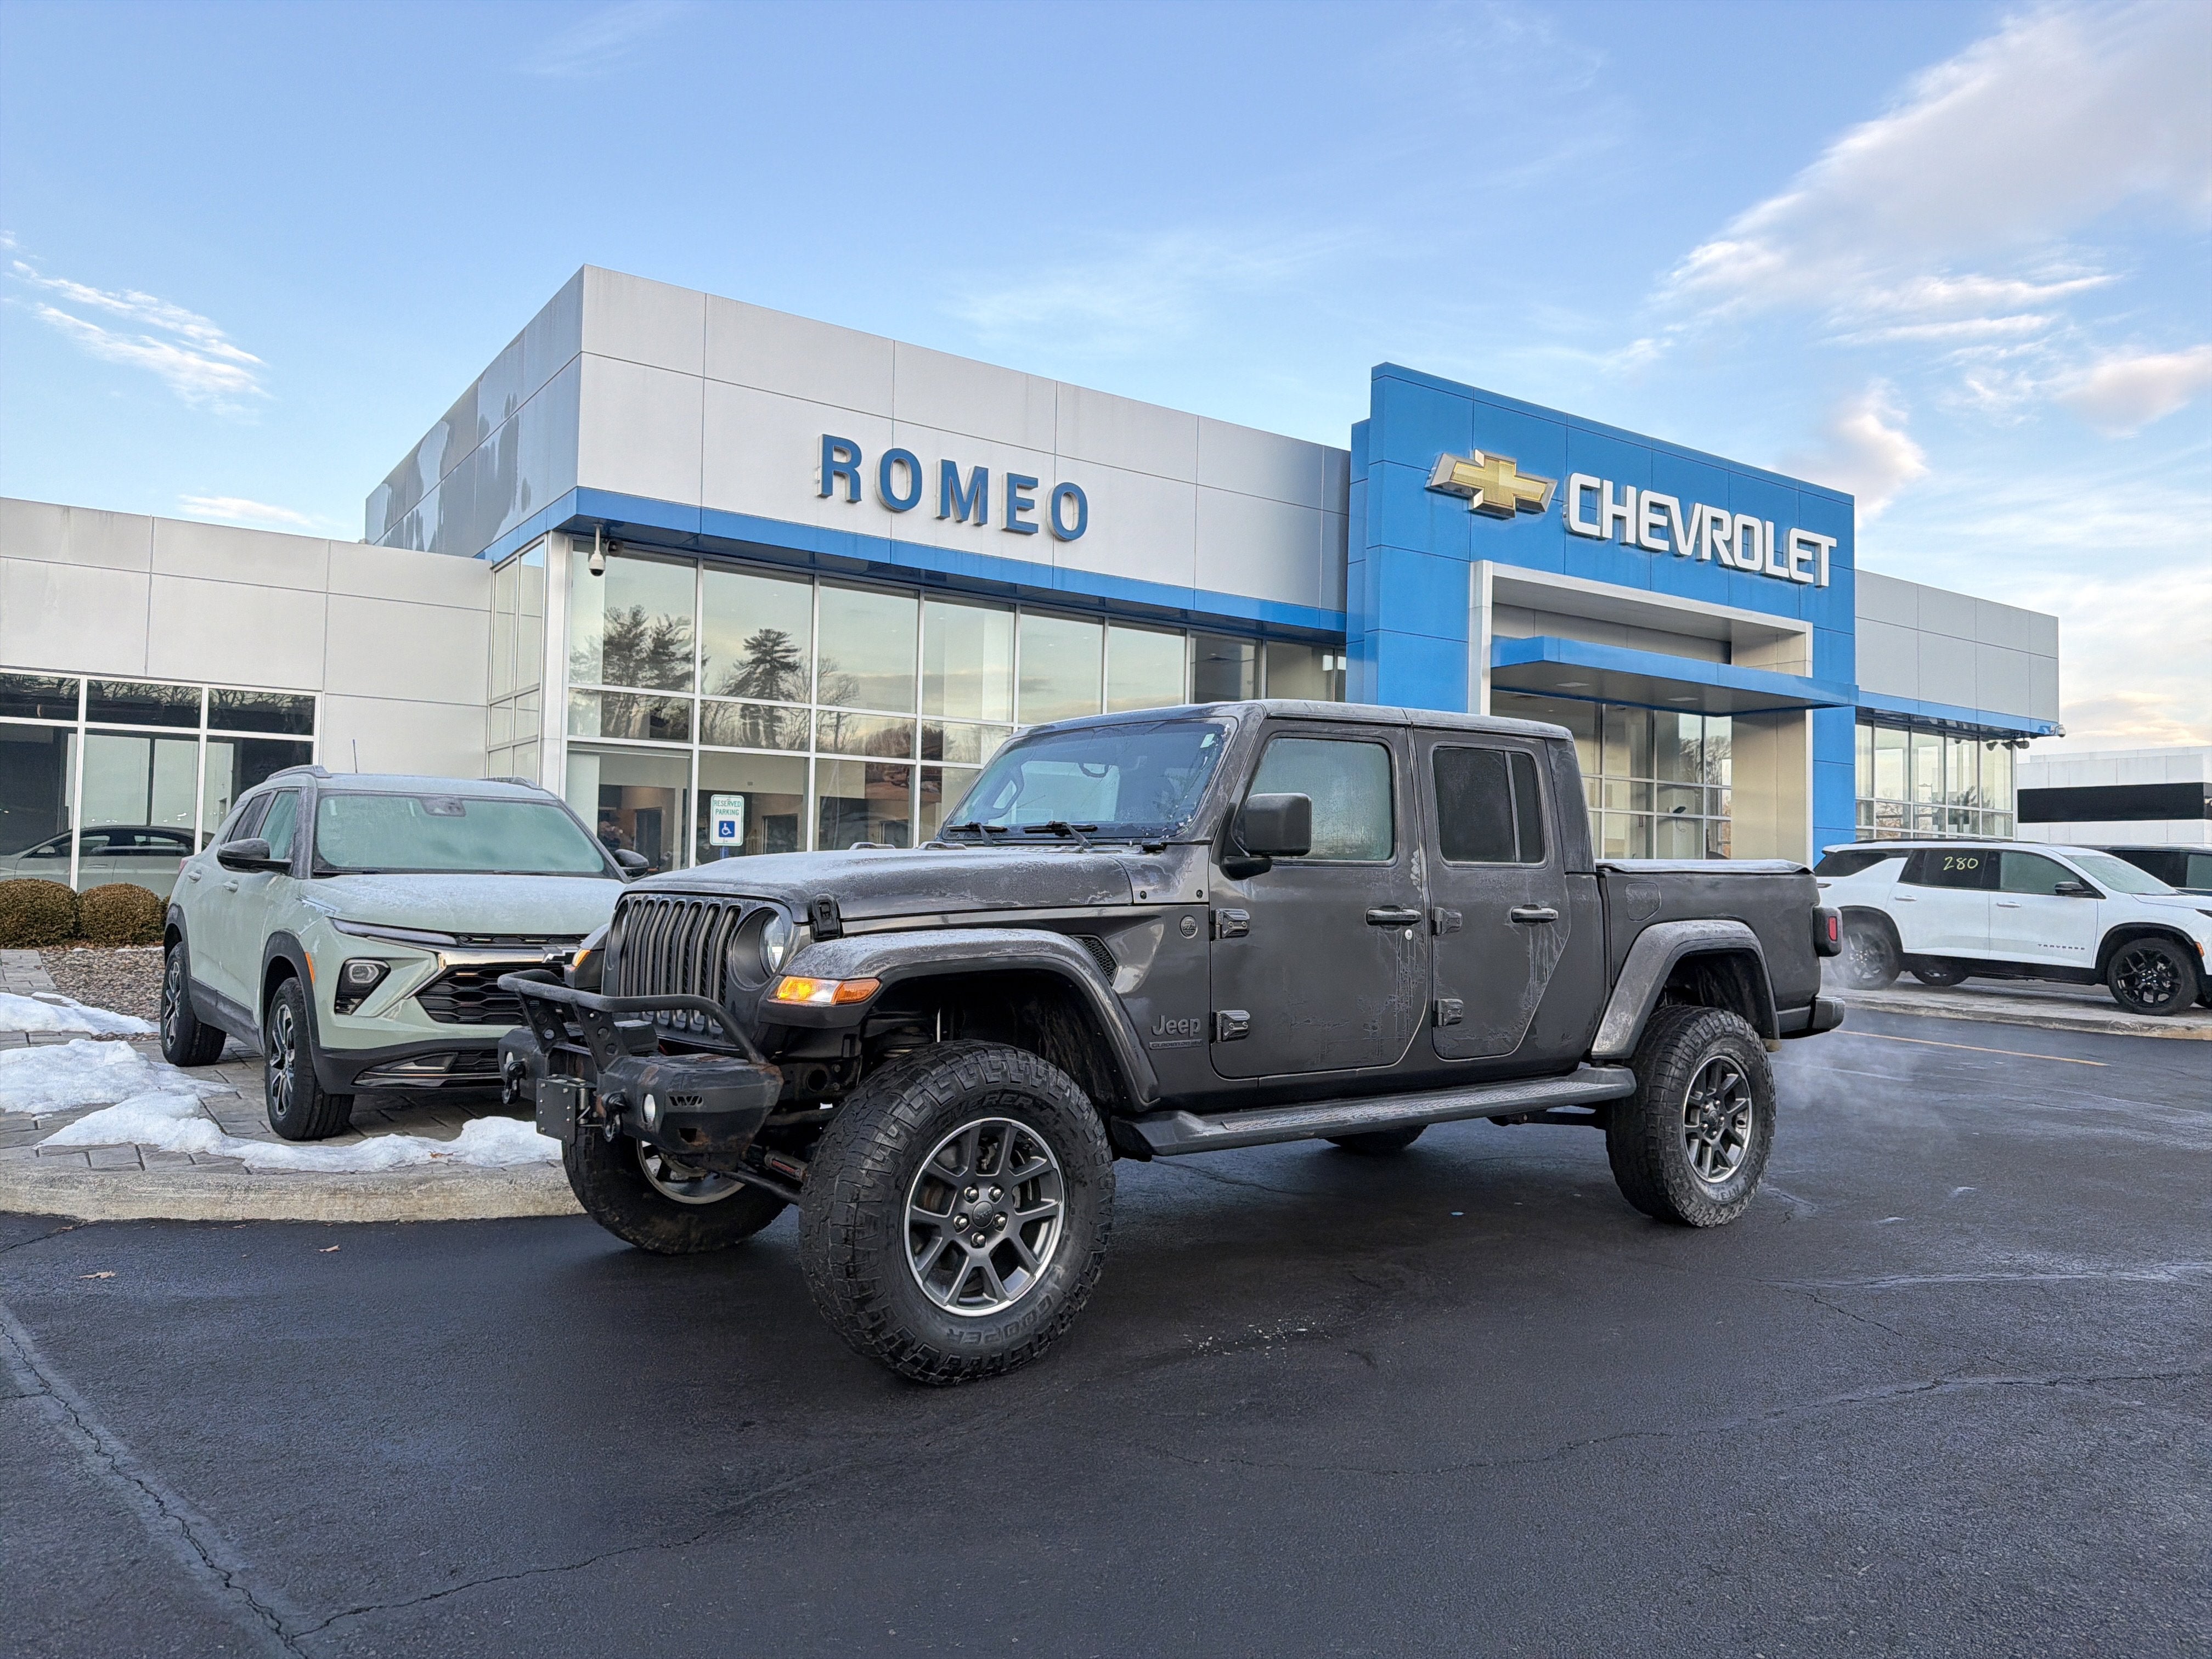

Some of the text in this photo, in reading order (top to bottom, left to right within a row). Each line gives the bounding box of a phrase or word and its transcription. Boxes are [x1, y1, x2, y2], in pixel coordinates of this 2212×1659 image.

[817, 433, 1088, 541] ROMEO
[1564, 472, 1837, 587] CHEVROLET
[1943, 856, 1978, 871] 280
[1151, 1015, 1201, 1038] Jeep
[946, 1294, 1053, 1345] COOPER
